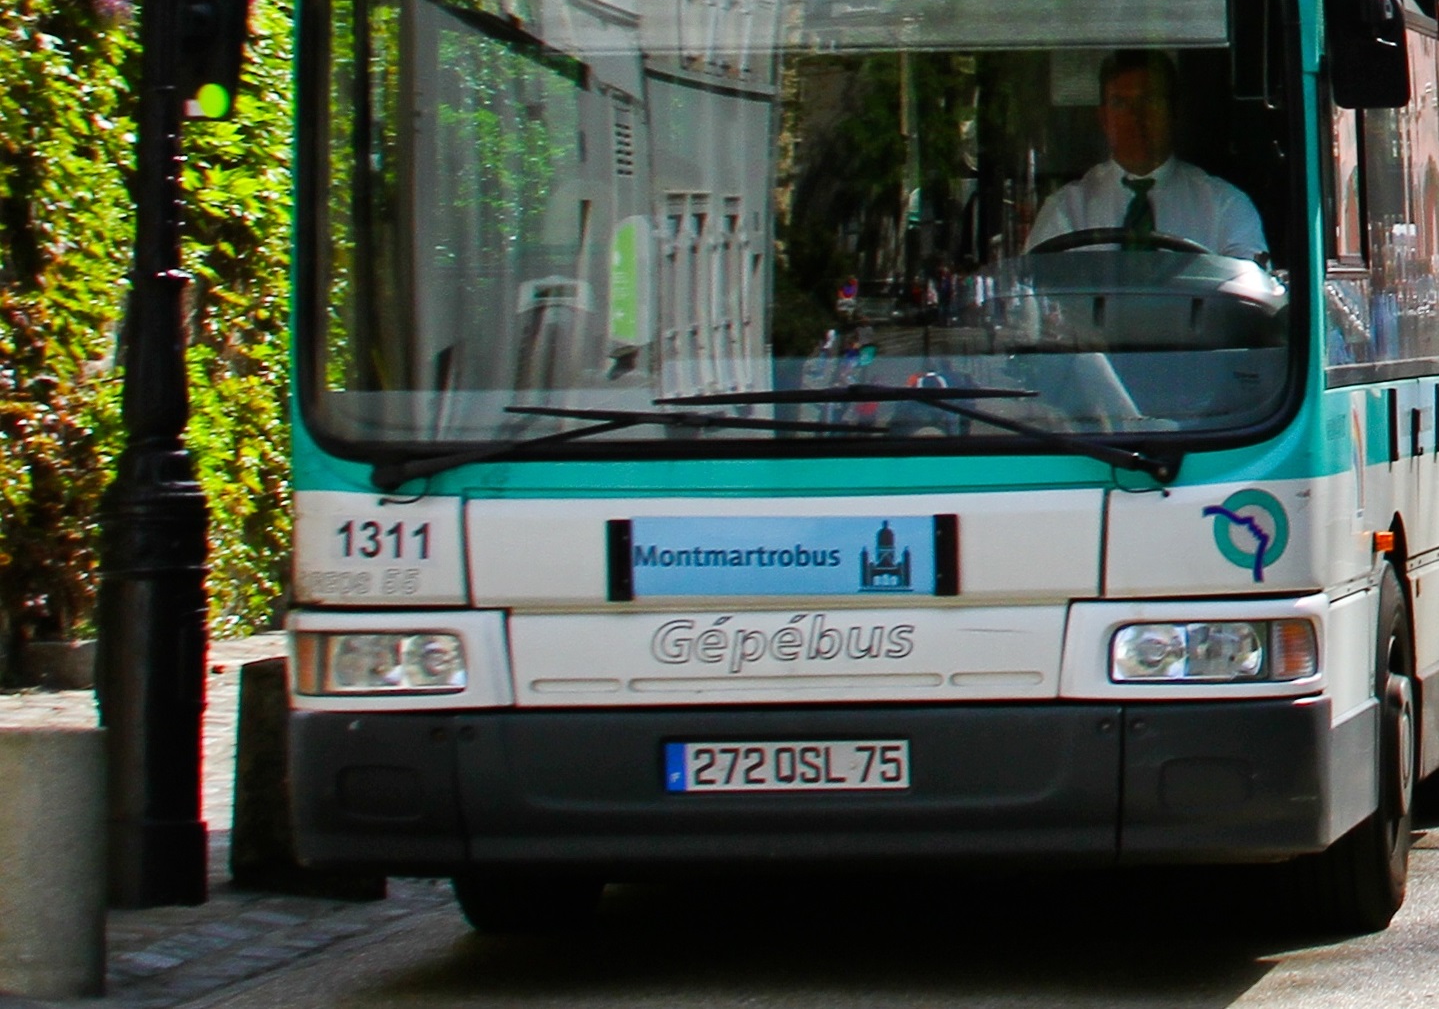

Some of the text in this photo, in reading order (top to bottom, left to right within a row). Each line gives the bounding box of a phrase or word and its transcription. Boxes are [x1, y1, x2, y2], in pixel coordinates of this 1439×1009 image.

[337, 519, 432, 560] 1311
[633, 544, 841, 569] Montmartrobus
[652, 613, 916, 674] Gépébus
[693, 747, 767, 785] 272
[855, 744, 903, 784] 75
